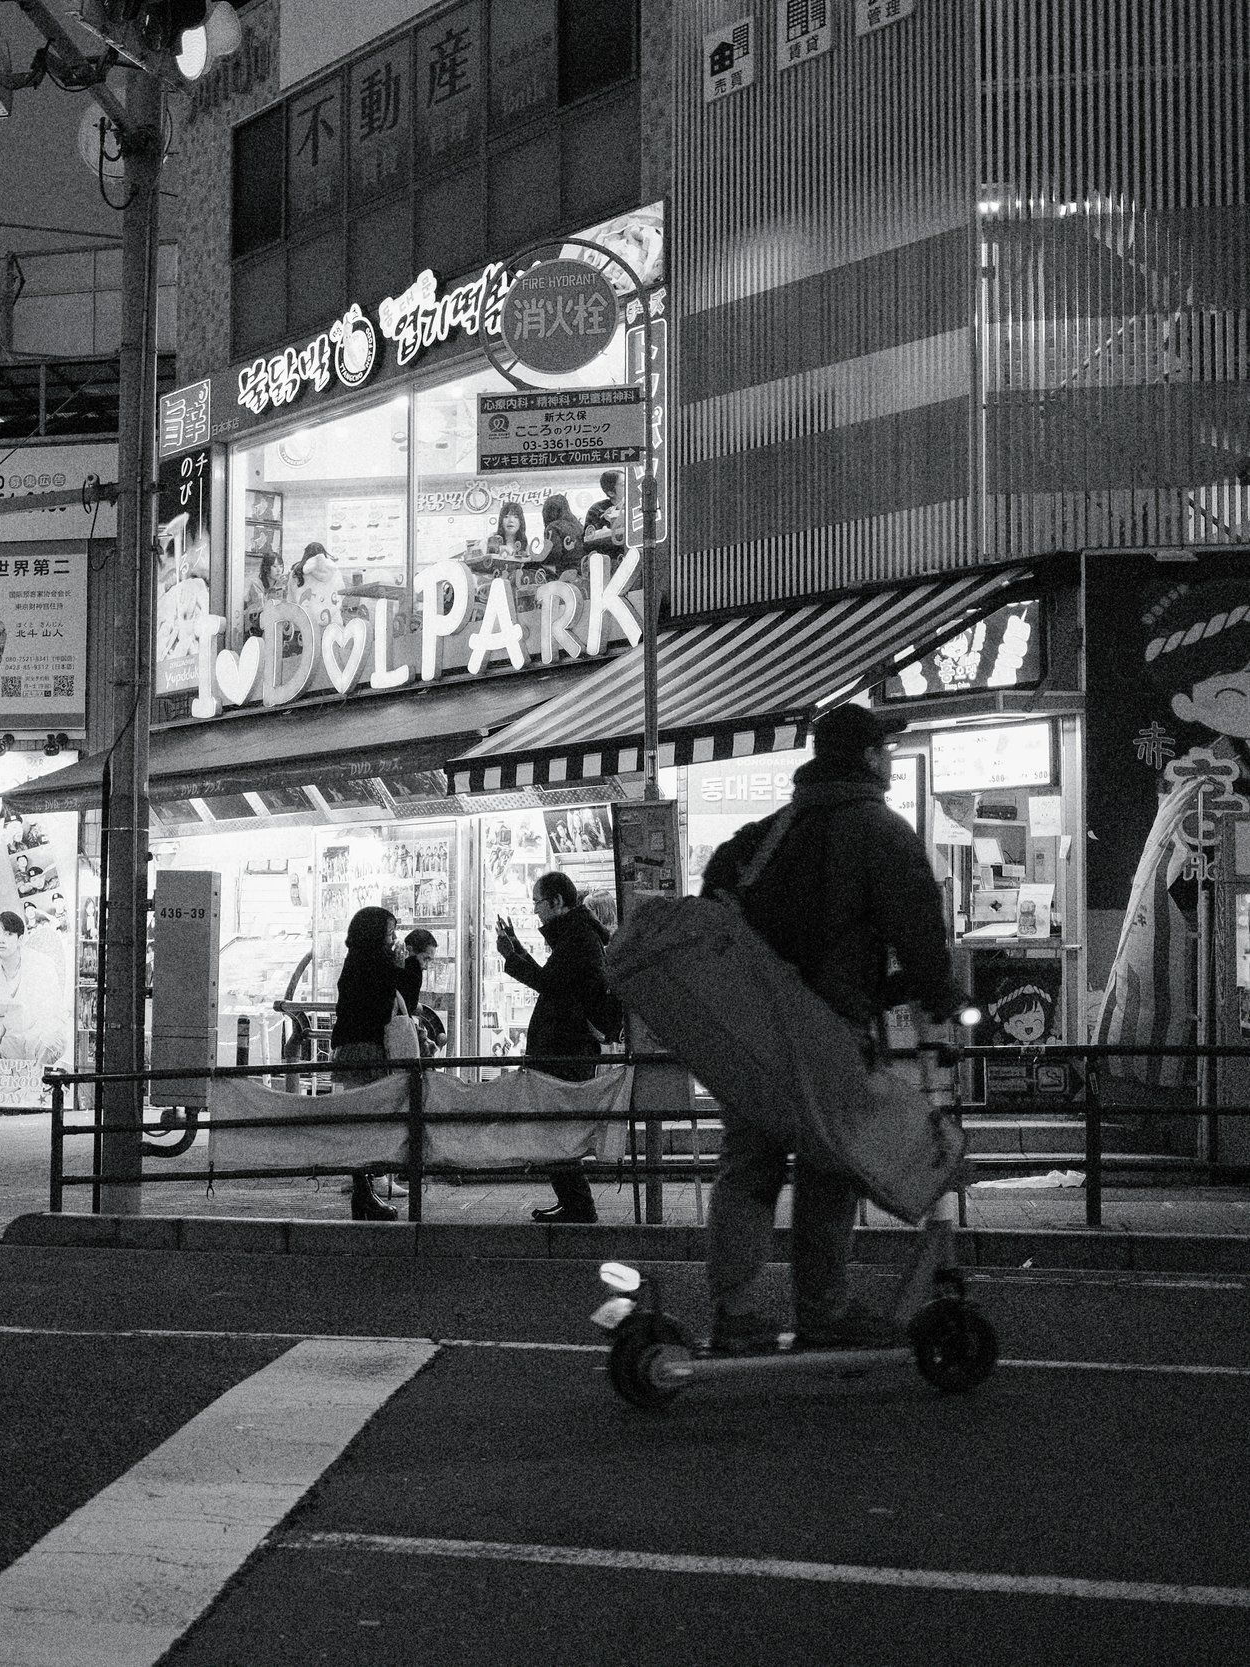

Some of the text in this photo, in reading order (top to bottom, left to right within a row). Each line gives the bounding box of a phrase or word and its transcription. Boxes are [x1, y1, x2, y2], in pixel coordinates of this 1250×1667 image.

[714, 70, 743, 95] 売買
[296, 26, 473, 167] 不動産
[522, 273, 597, 290] FIRE HYDRANT
[513, 292, 608, 340] 消火栓
[238, 334, 331, 414] 불닭발
[544, 410, 587, 422] 新大久保
[515, 422, 611, 438] こころのクリニック
[523, 437, 604, 451] 03-3361-0556
[15, 628, 64, 638] 北斗 山人
[160, 907, 206, 921] 436-39
